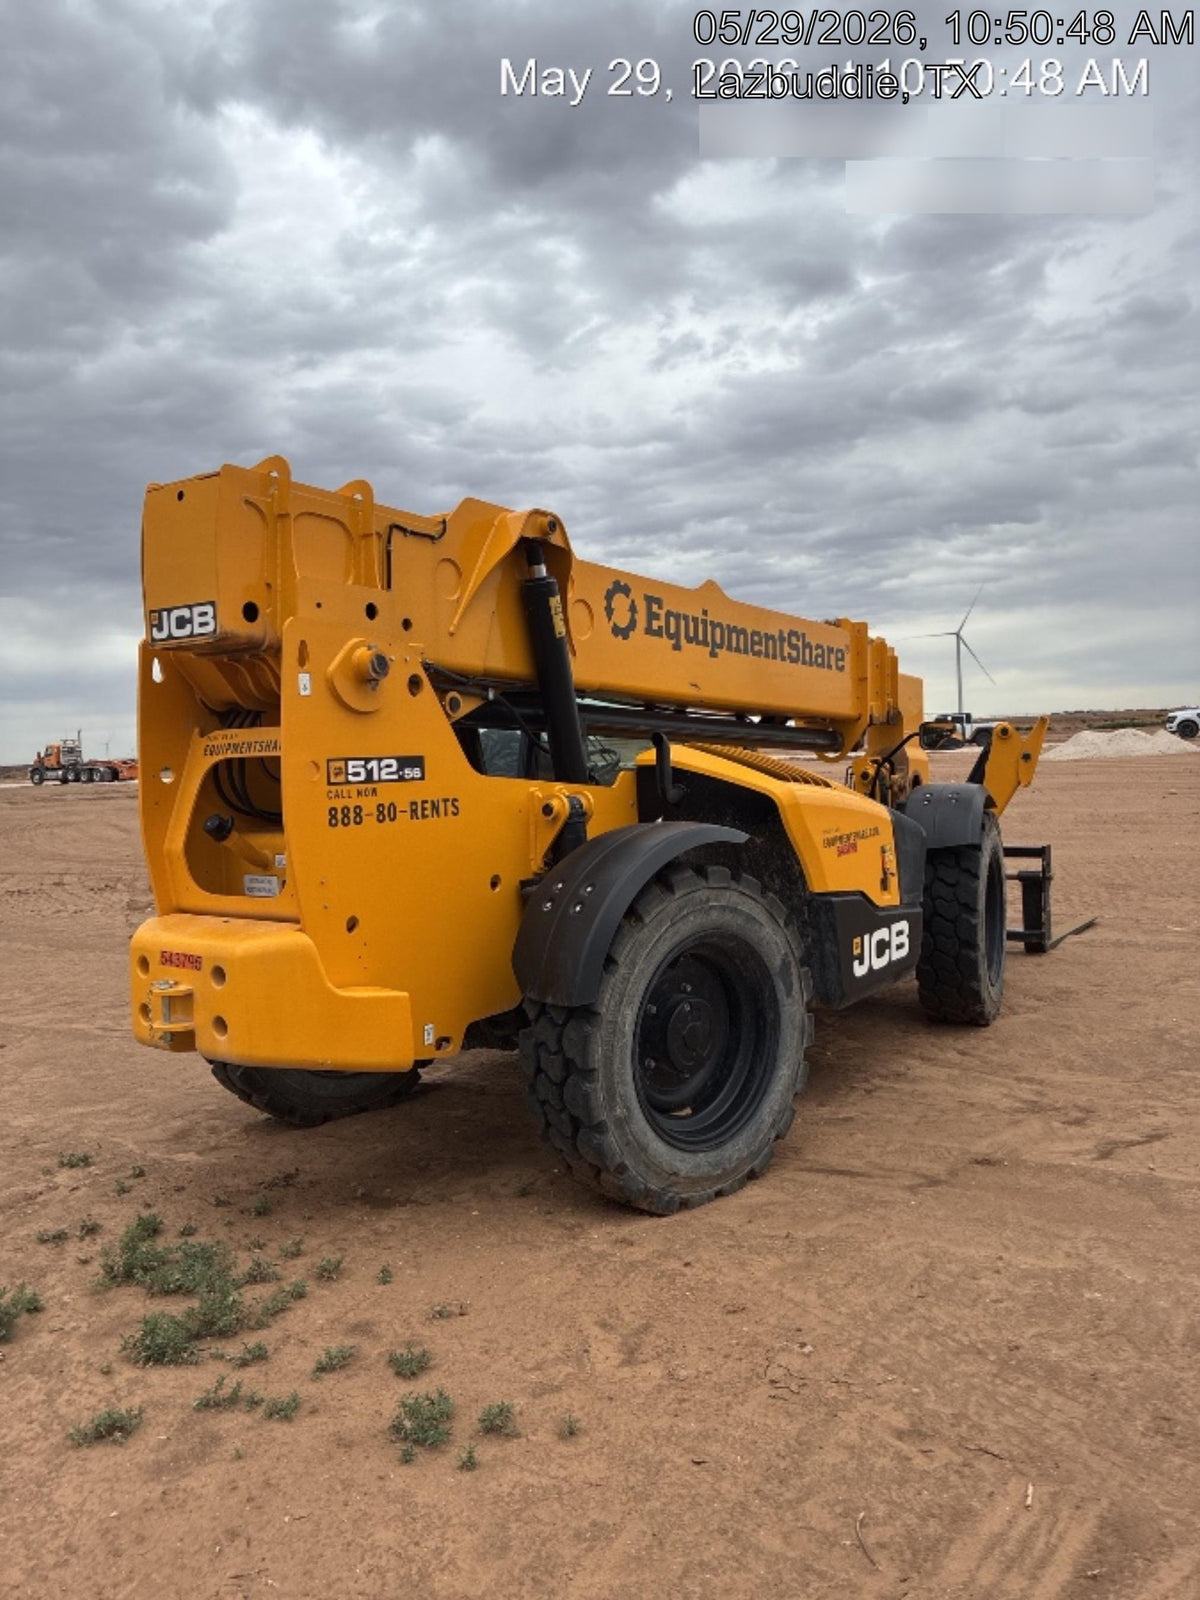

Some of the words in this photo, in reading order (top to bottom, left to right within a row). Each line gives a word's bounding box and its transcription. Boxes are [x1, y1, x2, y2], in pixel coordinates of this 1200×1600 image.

[152, 603, 216, 640] JCB
[643, 593, 846, 672] EquipmentShare
[203, 739, 281, 757] EQUIPMENTSHA
[326, 789, 353, 801] CALL
[357, 787, 378, 798] NOW
[328, 798, 460, 828] 888-80-RENTS
[852, 920, 910, 977] JCB
